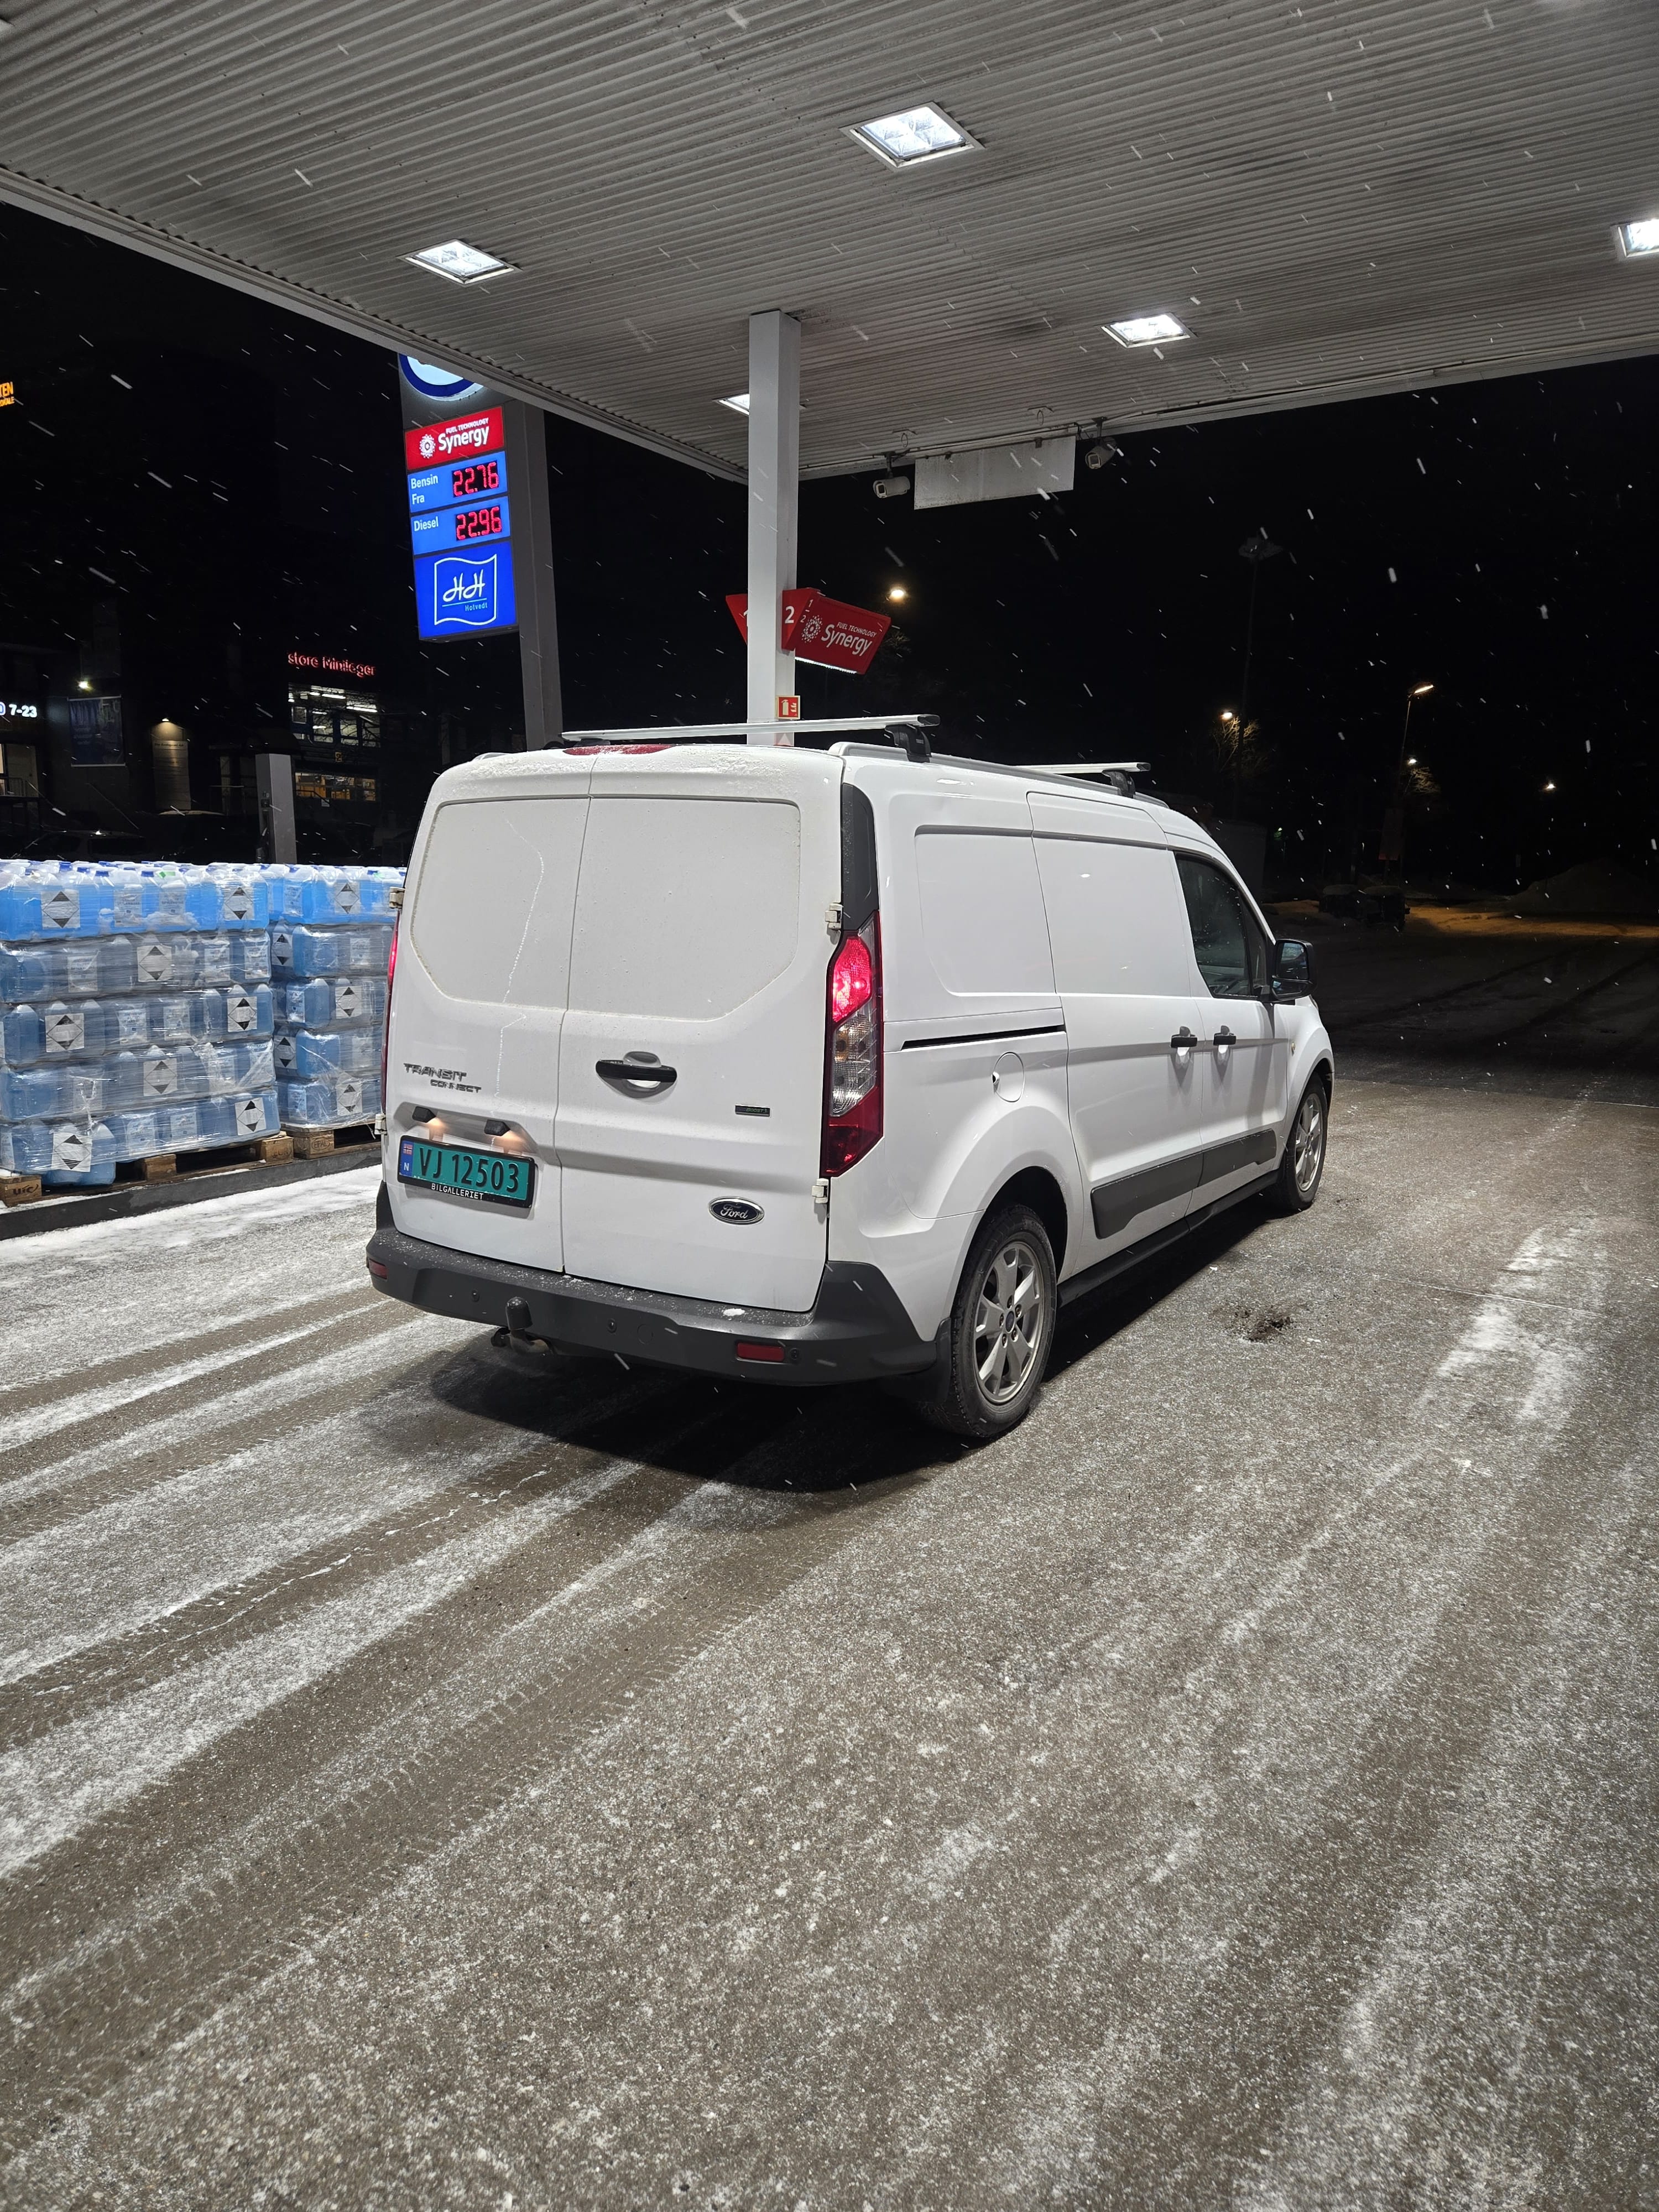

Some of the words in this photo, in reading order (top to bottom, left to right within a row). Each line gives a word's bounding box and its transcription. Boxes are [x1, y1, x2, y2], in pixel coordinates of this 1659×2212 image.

[457, 418, 489, 431] TECHNOLOGY
[437, 426, 490, 453] Synergy
[410, 474, 439, 489] Bensin
[453, 461, 499, 497] 22.76
[412, 493, 425, 504] Fra
[414, 516, 439, 531] Diesel
[456, 506, 502, 540] 22.96
[808, 599, 813, 607] 1
[784, 606, 795, 624] 2
[836, 622, 848, 630] FUEL
[848, 625, 877, 638] TECHNOLOGY
[821, 624, 873, 656] Synergy
[8, 703, 37, 718] 7-23
[403, 1063, 467, 1082] TRANSIT
[430, 1079, 482, 1093] CONNECT
[403, 1163, 410, 1171] N
[419, 1147, 442, 1179] VJ
[452, 1154, 519, 1193] 12503
[431, 1183, 484, 1200] BILGALLERIET
[720, 1204, 748, 1219] Ford
